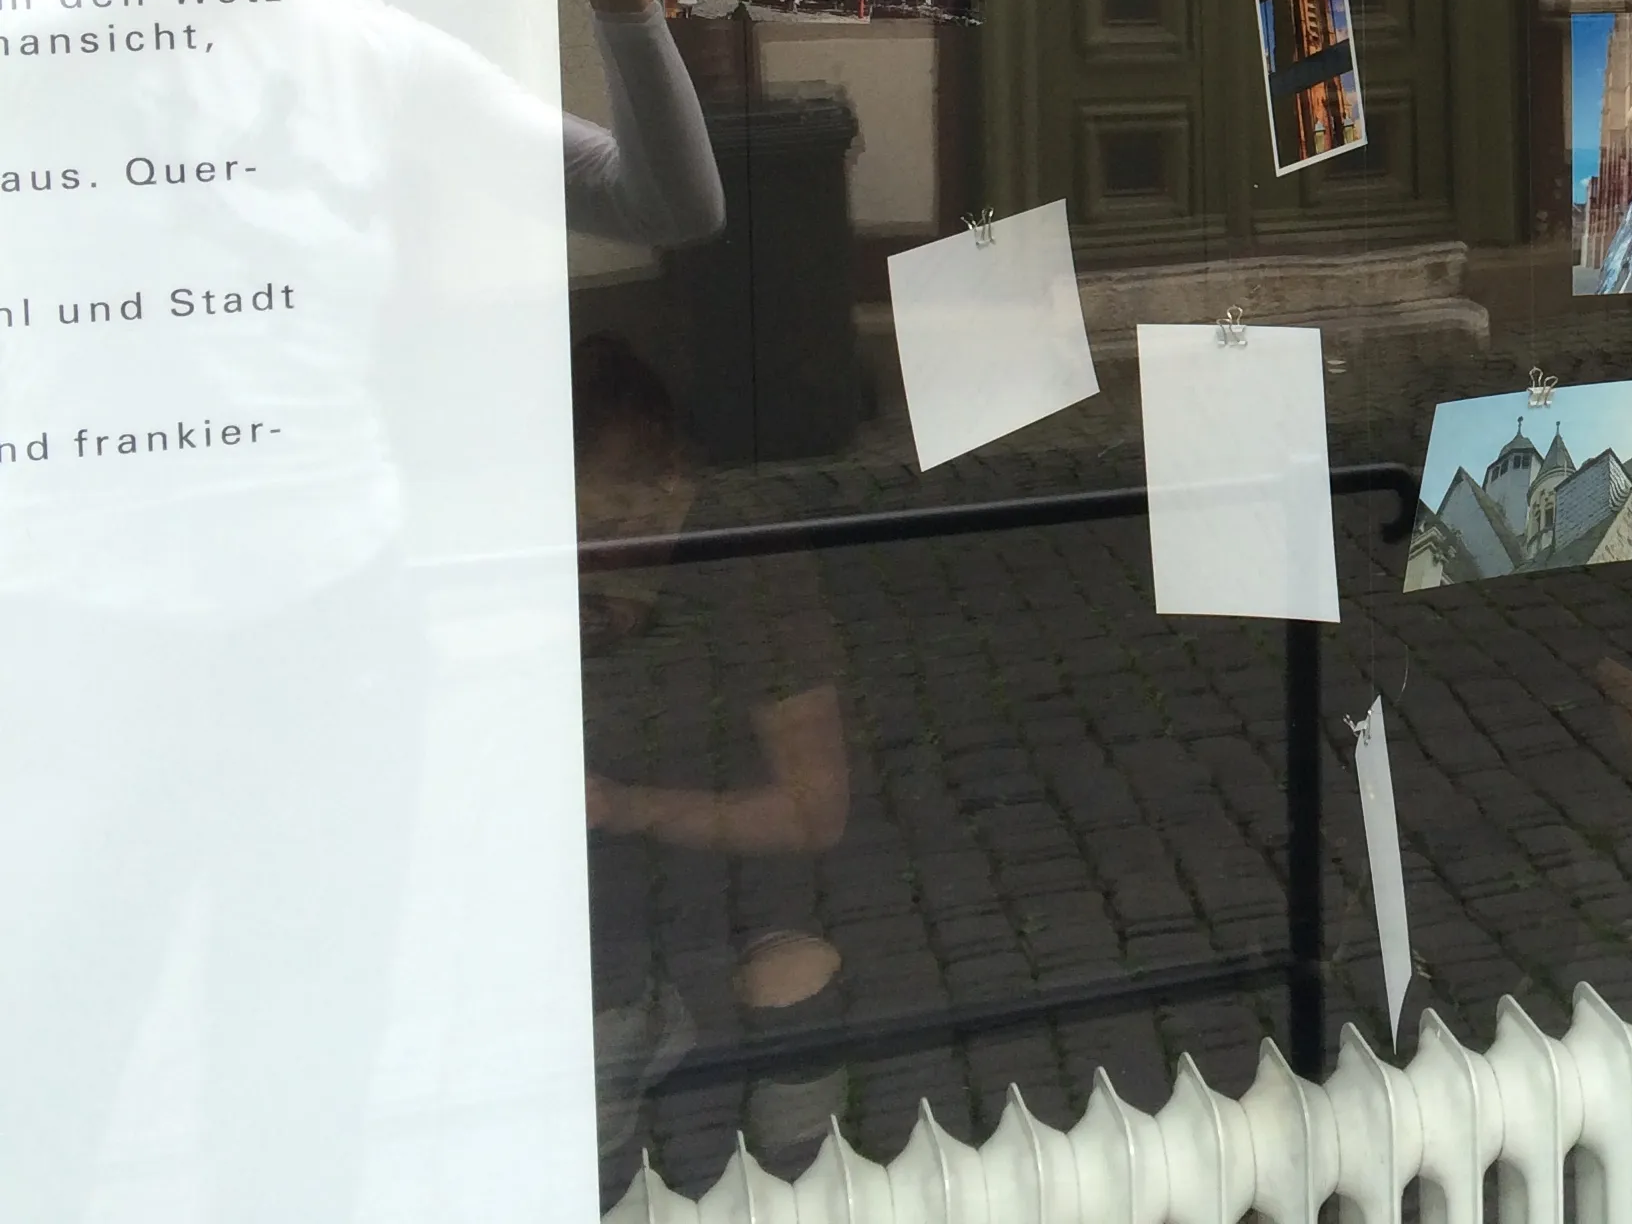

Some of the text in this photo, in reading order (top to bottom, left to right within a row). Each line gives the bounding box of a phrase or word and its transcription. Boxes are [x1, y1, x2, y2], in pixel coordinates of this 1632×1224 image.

[1, 157, 257, 193] aus. Quer-
[58, 291, 143, 325] und
[170, 282, 295, 317] Stadt
[73, 421, 281, 458] frankier-
